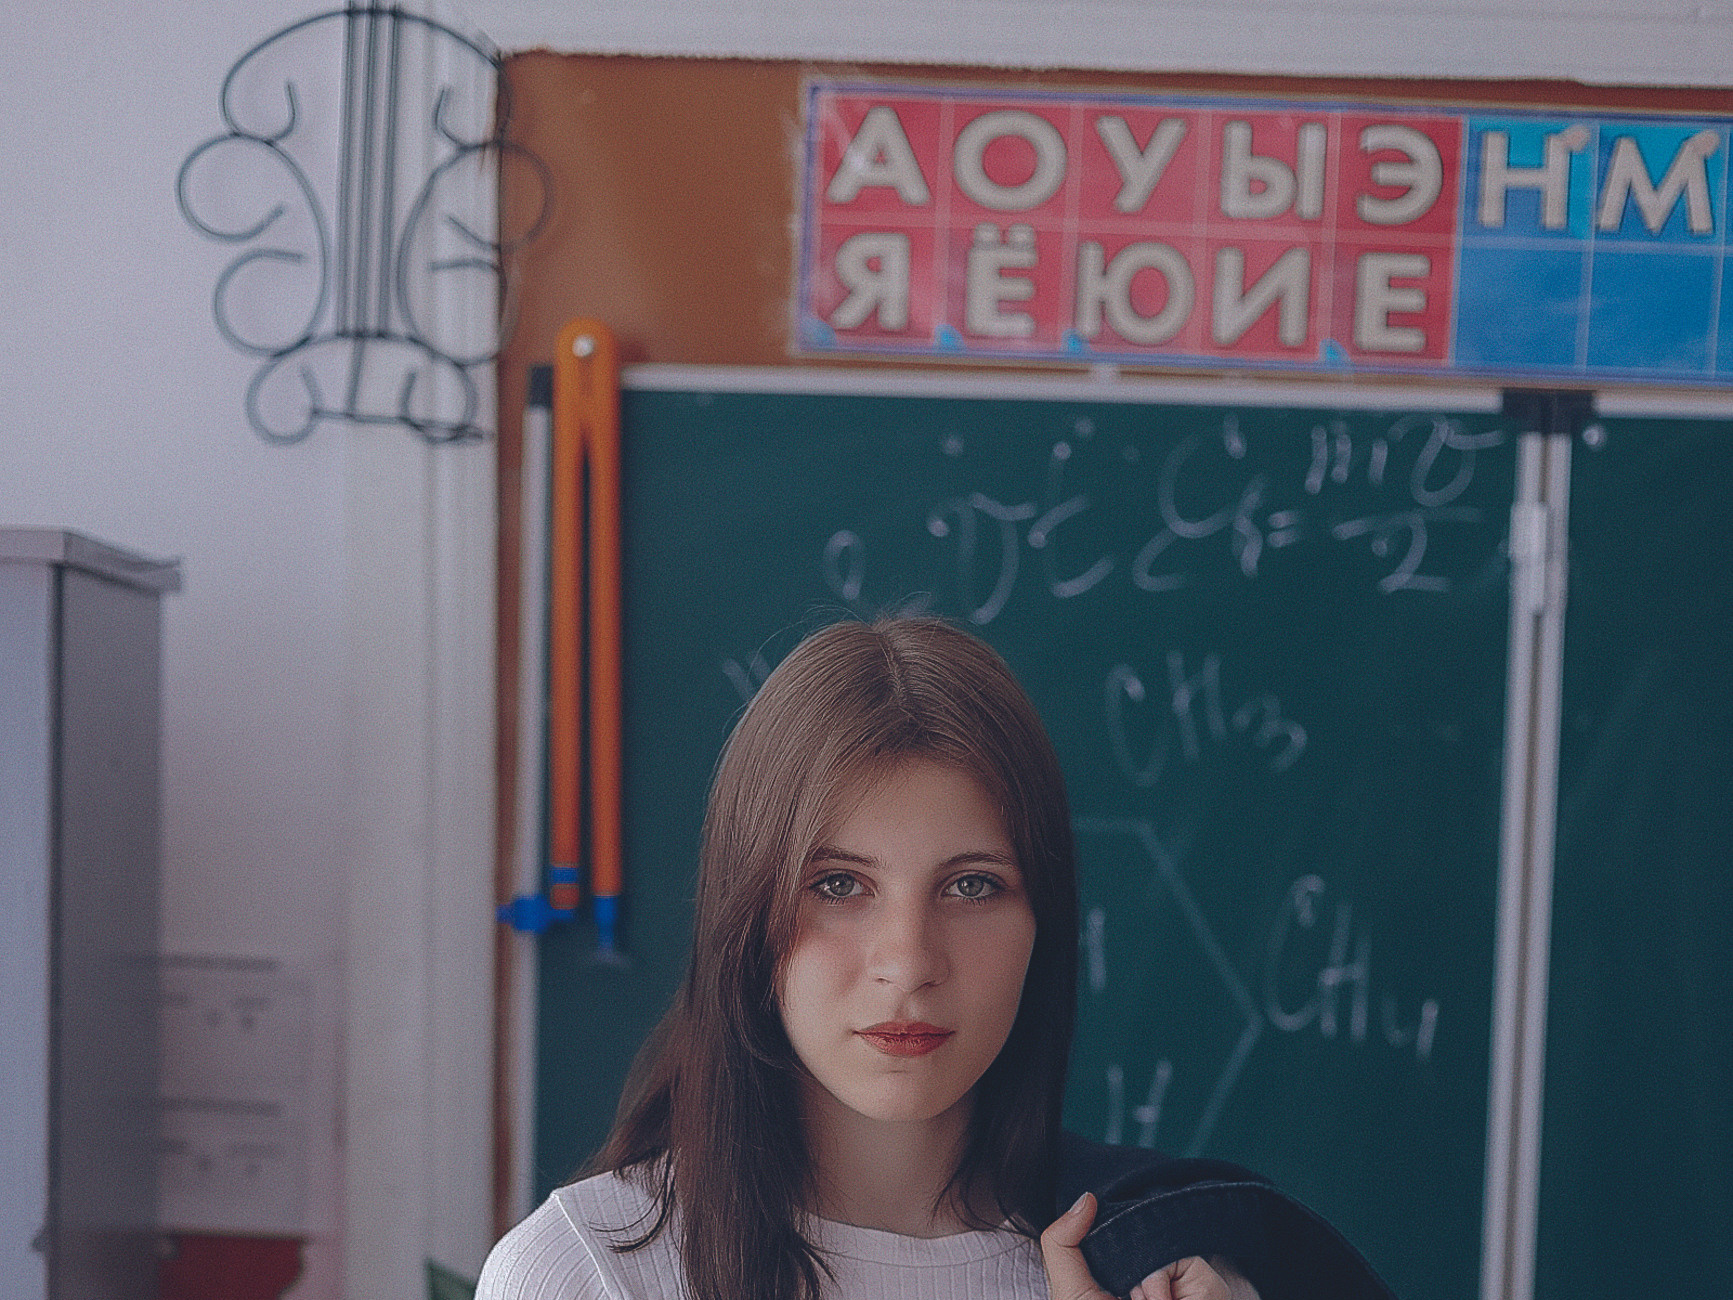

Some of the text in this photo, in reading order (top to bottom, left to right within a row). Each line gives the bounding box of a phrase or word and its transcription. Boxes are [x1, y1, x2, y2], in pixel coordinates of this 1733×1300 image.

[825, 105, 1444, 225] А О У Ы Э
[1476, 130, 1714, 235] Н М
[830, 221, 1433, 353] Я Ё Ю И Е
